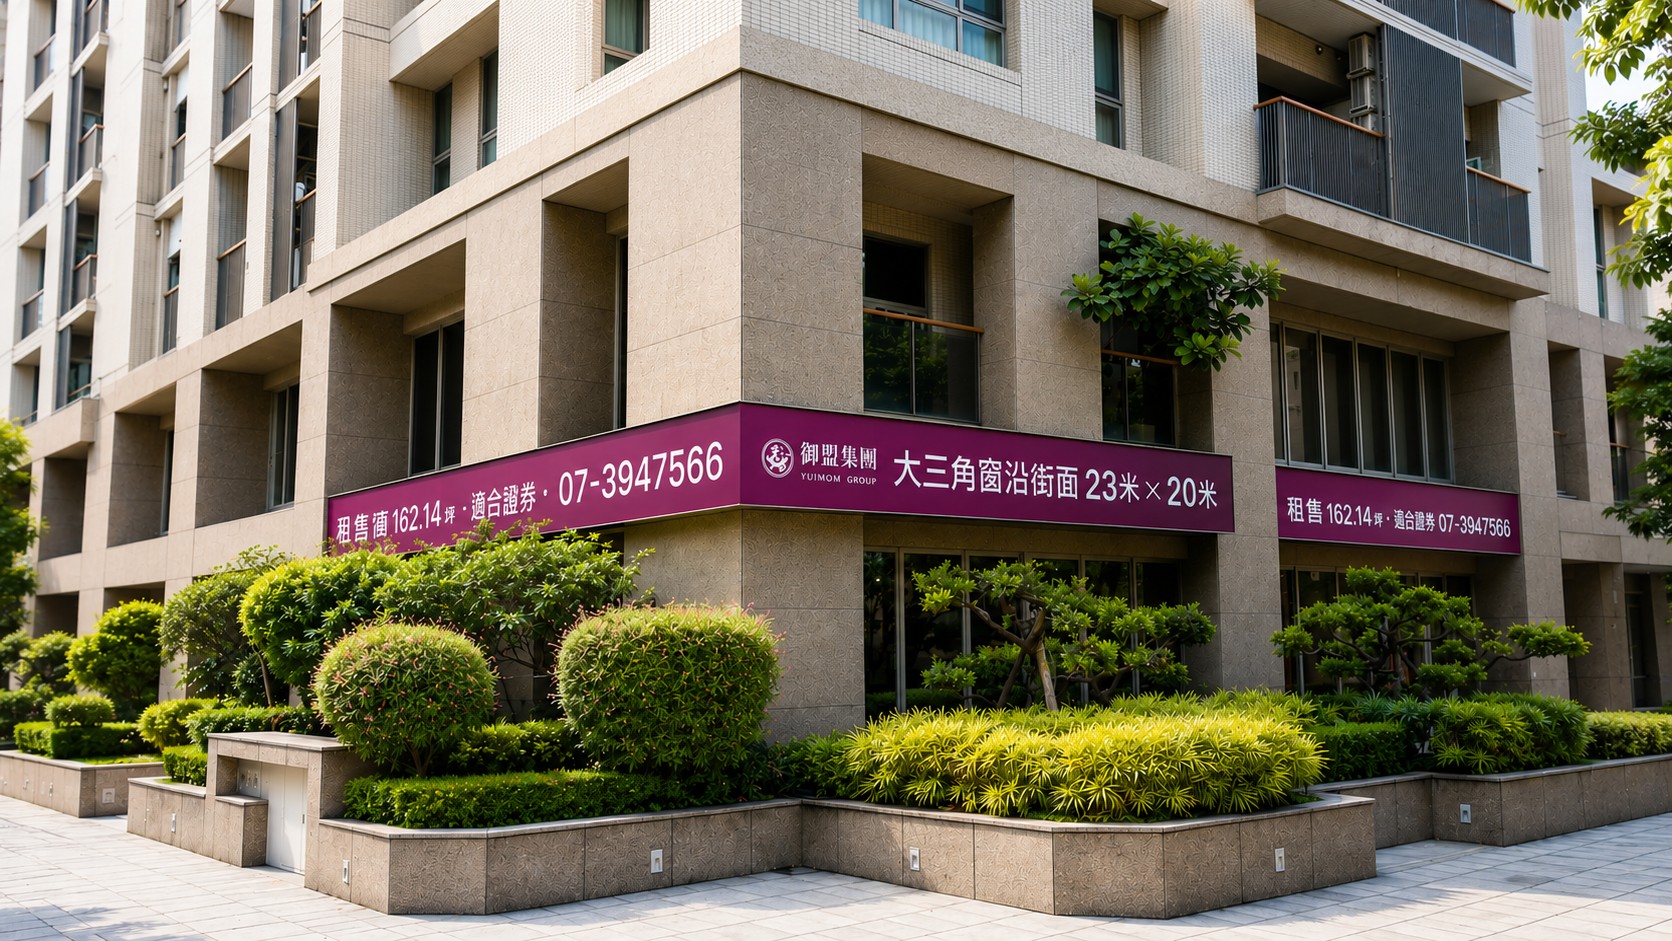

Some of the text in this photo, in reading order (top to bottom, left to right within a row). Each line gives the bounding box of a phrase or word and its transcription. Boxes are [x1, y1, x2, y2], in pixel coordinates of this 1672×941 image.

[800, 441, 877, 471] 御盟集團
[558, 441, 724, 506] 07-3947566
[801, 472, 877, 485] YUIMOM GROUP
[1438, 514, 1511, 537] 07-3947566
